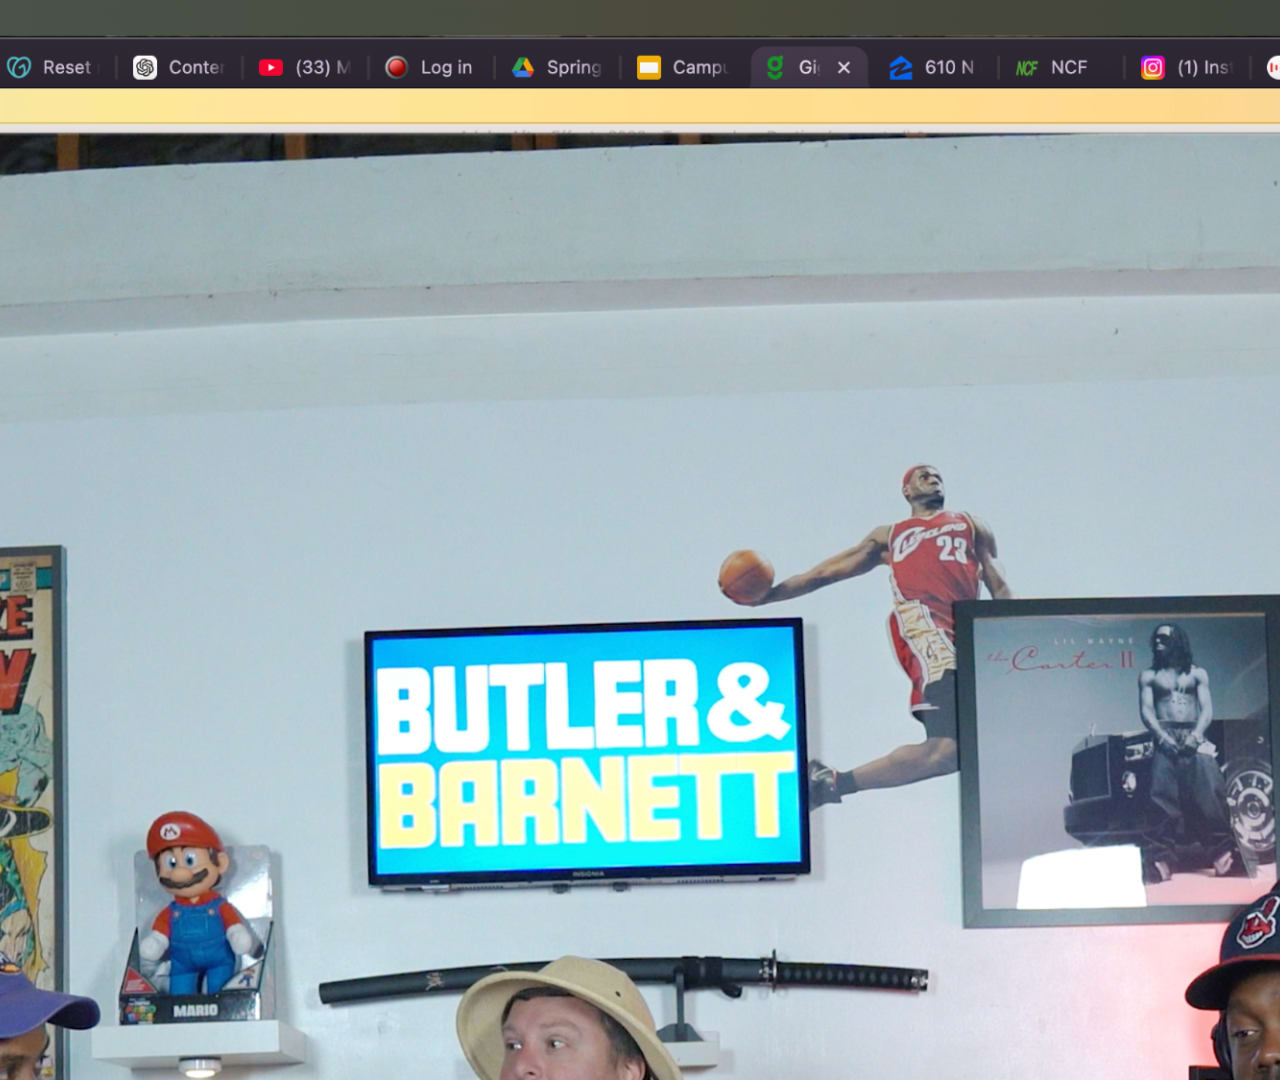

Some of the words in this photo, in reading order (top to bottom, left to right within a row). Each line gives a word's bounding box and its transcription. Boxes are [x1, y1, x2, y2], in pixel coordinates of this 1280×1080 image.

[44, 60, 91, 74] Reset
[296, 59, 330, 78] (33)
[422, 59, 450, 78] Log
[458, 59, 472, 74] in
[547, 59, 601, 78] Spring
[925, 59, 956, 75] 610
[962, 59, 974, 74] N
[1052, 59, 1088, 75] NCF
[1178, 59, 1199, 78] (1)
[936, 535, 968, 564] 23
[1054, 638, 1077, 646] LIL
[1088, 637, 1134, 646] WAYNE
[376, 659, 699, 755] BUTLER
[706, 661, 792, 743] &
[378, 751, 796, 849] BARNETT
[173, 1004, 219, 1018] MARIO
